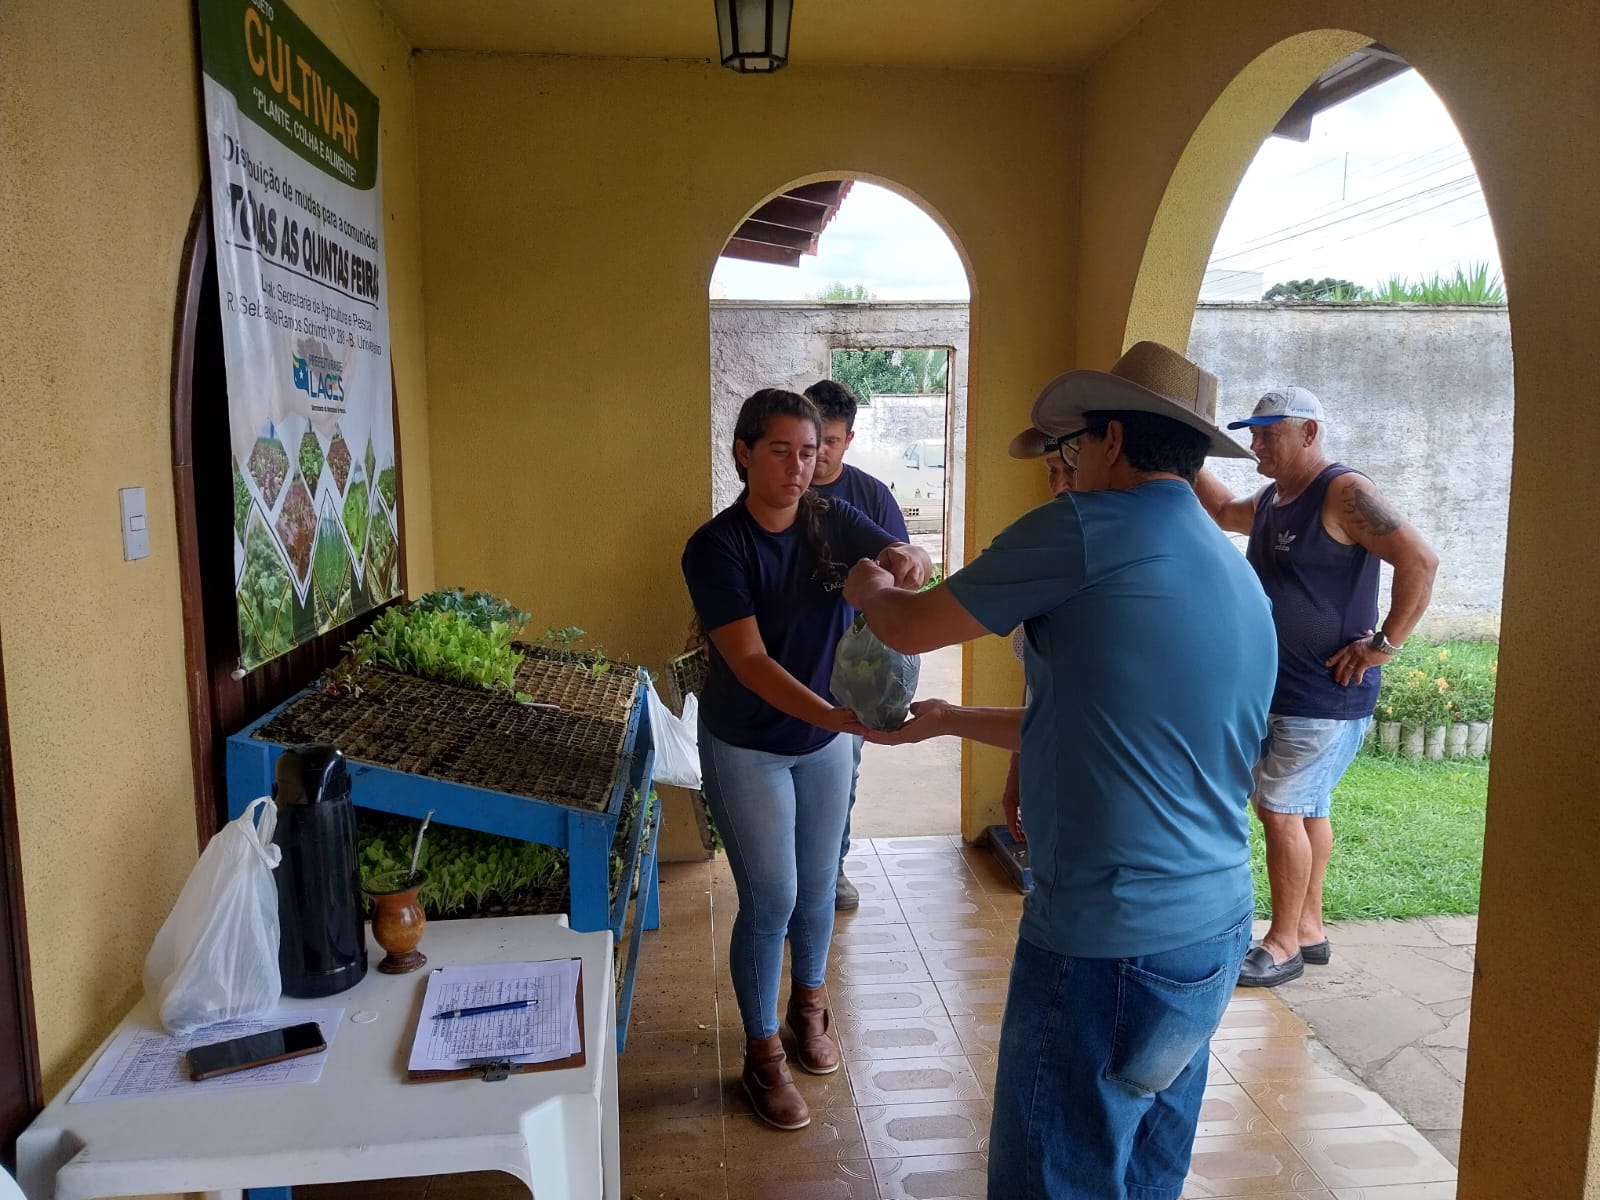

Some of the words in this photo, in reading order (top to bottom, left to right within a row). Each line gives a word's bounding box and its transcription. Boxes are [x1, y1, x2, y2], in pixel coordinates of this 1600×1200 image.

[252, 0, 274, 21] JETO
[244, 7, 359, 161] CULTIVAR
[293, 120, 319, 156] COLHA
[282, 177, 293, 202] de
[295, 188, 321, 219] mudas
[322, 205, 337, 229] para
[281, 215, 299, 267] AS
[302, 227, 349, 290] QUINTAS
[277, 284, 312, 312] Secretaria
[309, 370, 345, 402] LAGES
